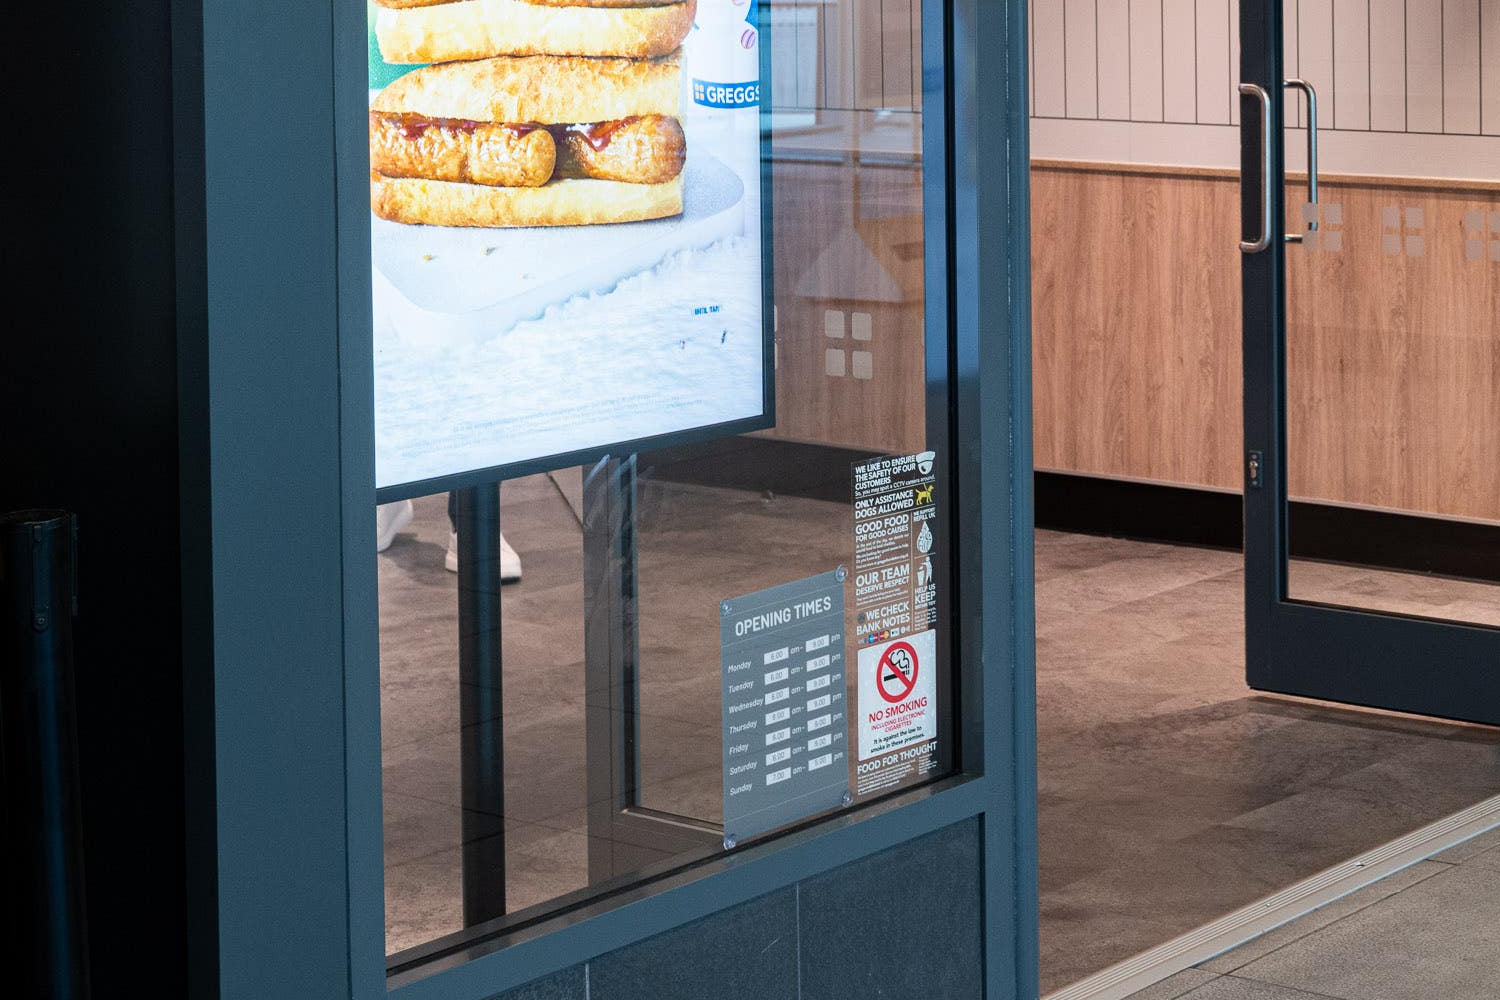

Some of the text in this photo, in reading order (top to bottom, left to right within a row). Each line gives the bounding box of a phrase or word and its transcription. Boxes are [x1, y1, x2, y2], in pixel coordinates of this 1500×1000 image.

[855, 455, 915, 474] WE LIKE TO ENSURE
[855, 472, 868, 482] THE
[869, 469, 891, 480] SAFETY
[902, 463, 915, 472] OUR
[855, 476, 891, 490] CUSTOMERS
[855, 490, 914, 509] ONLY ASSISTANCE
[855, 499, 914, 519] DOGS ALLOWED
[856, 514, 909, 535] GOOD FOOD
[856, 524, 909, 543] FOR GOOD CAUSES
[856, 564, 910, 587] OUR TEAM
[856, 576, 910, 596] DESERVE RESPECT
[915, 590, 936, 604] KEEP
[928, 583, 936, 591] US
[735, 607, 791, 636] OPENING
[794, 596, 831, 619] TIMES
[866, 601, 909, 621] WE CHECK
[856, 620, 880, 636] BANK
[882, 612, 910, 628] NOTES
[728, 661, 751, 673] Monday
[831, 633, 841, 643] pm
[728, 681, 754, 694] Tuesday
[831, 653, 841, 663] pm
[728, 697, 763, 714] Wednesday
[831, 673, 841, 683] pm
[729, 720, 757, 735] Thursday
[832, 693, 842, 703] pm
[868, 697, 927, 723] NO SMOKING
[871, 709, 926, 731] INCLUDING ELECTRONIC
[729, 743, 749, 755] Friday
[833, 712, 842, 723] pm
[884, 720, 912, 733] CIGARETTES
[870, 745, 885, 753] smoke
[891, 739, 904, 747] these
[883, 732, 899, 743] against
[729, 761, 758, 776] Saturday
[833, 732, 843, 742] pm
[857, 759, 880, 775] FOOD
[882, 753, 899, 767] FOR
[900, 741, 938, 760] THOUGHT
[730, 783, 753, 796] Sunday
[833, 752, 843, 762] pm
